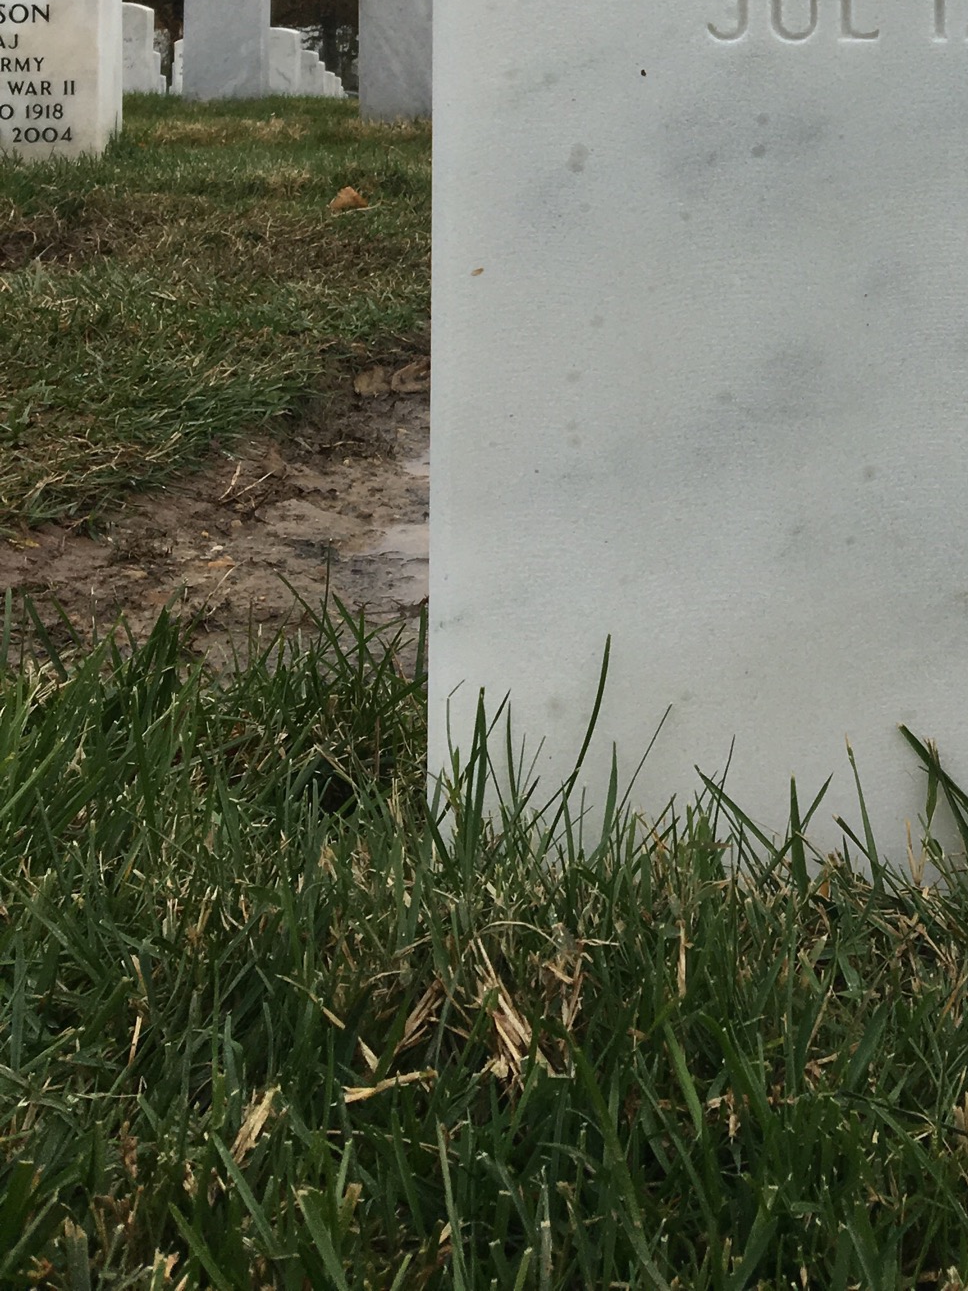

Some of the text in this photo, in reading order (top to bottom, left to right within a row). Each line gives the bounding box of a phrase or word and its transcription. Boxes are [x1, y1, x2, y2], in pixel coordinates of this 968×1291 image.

[7, 80, 52, 96] WAR
[25, 103, 64, 120] 1918
[12, 126, 73, 144] 2004
